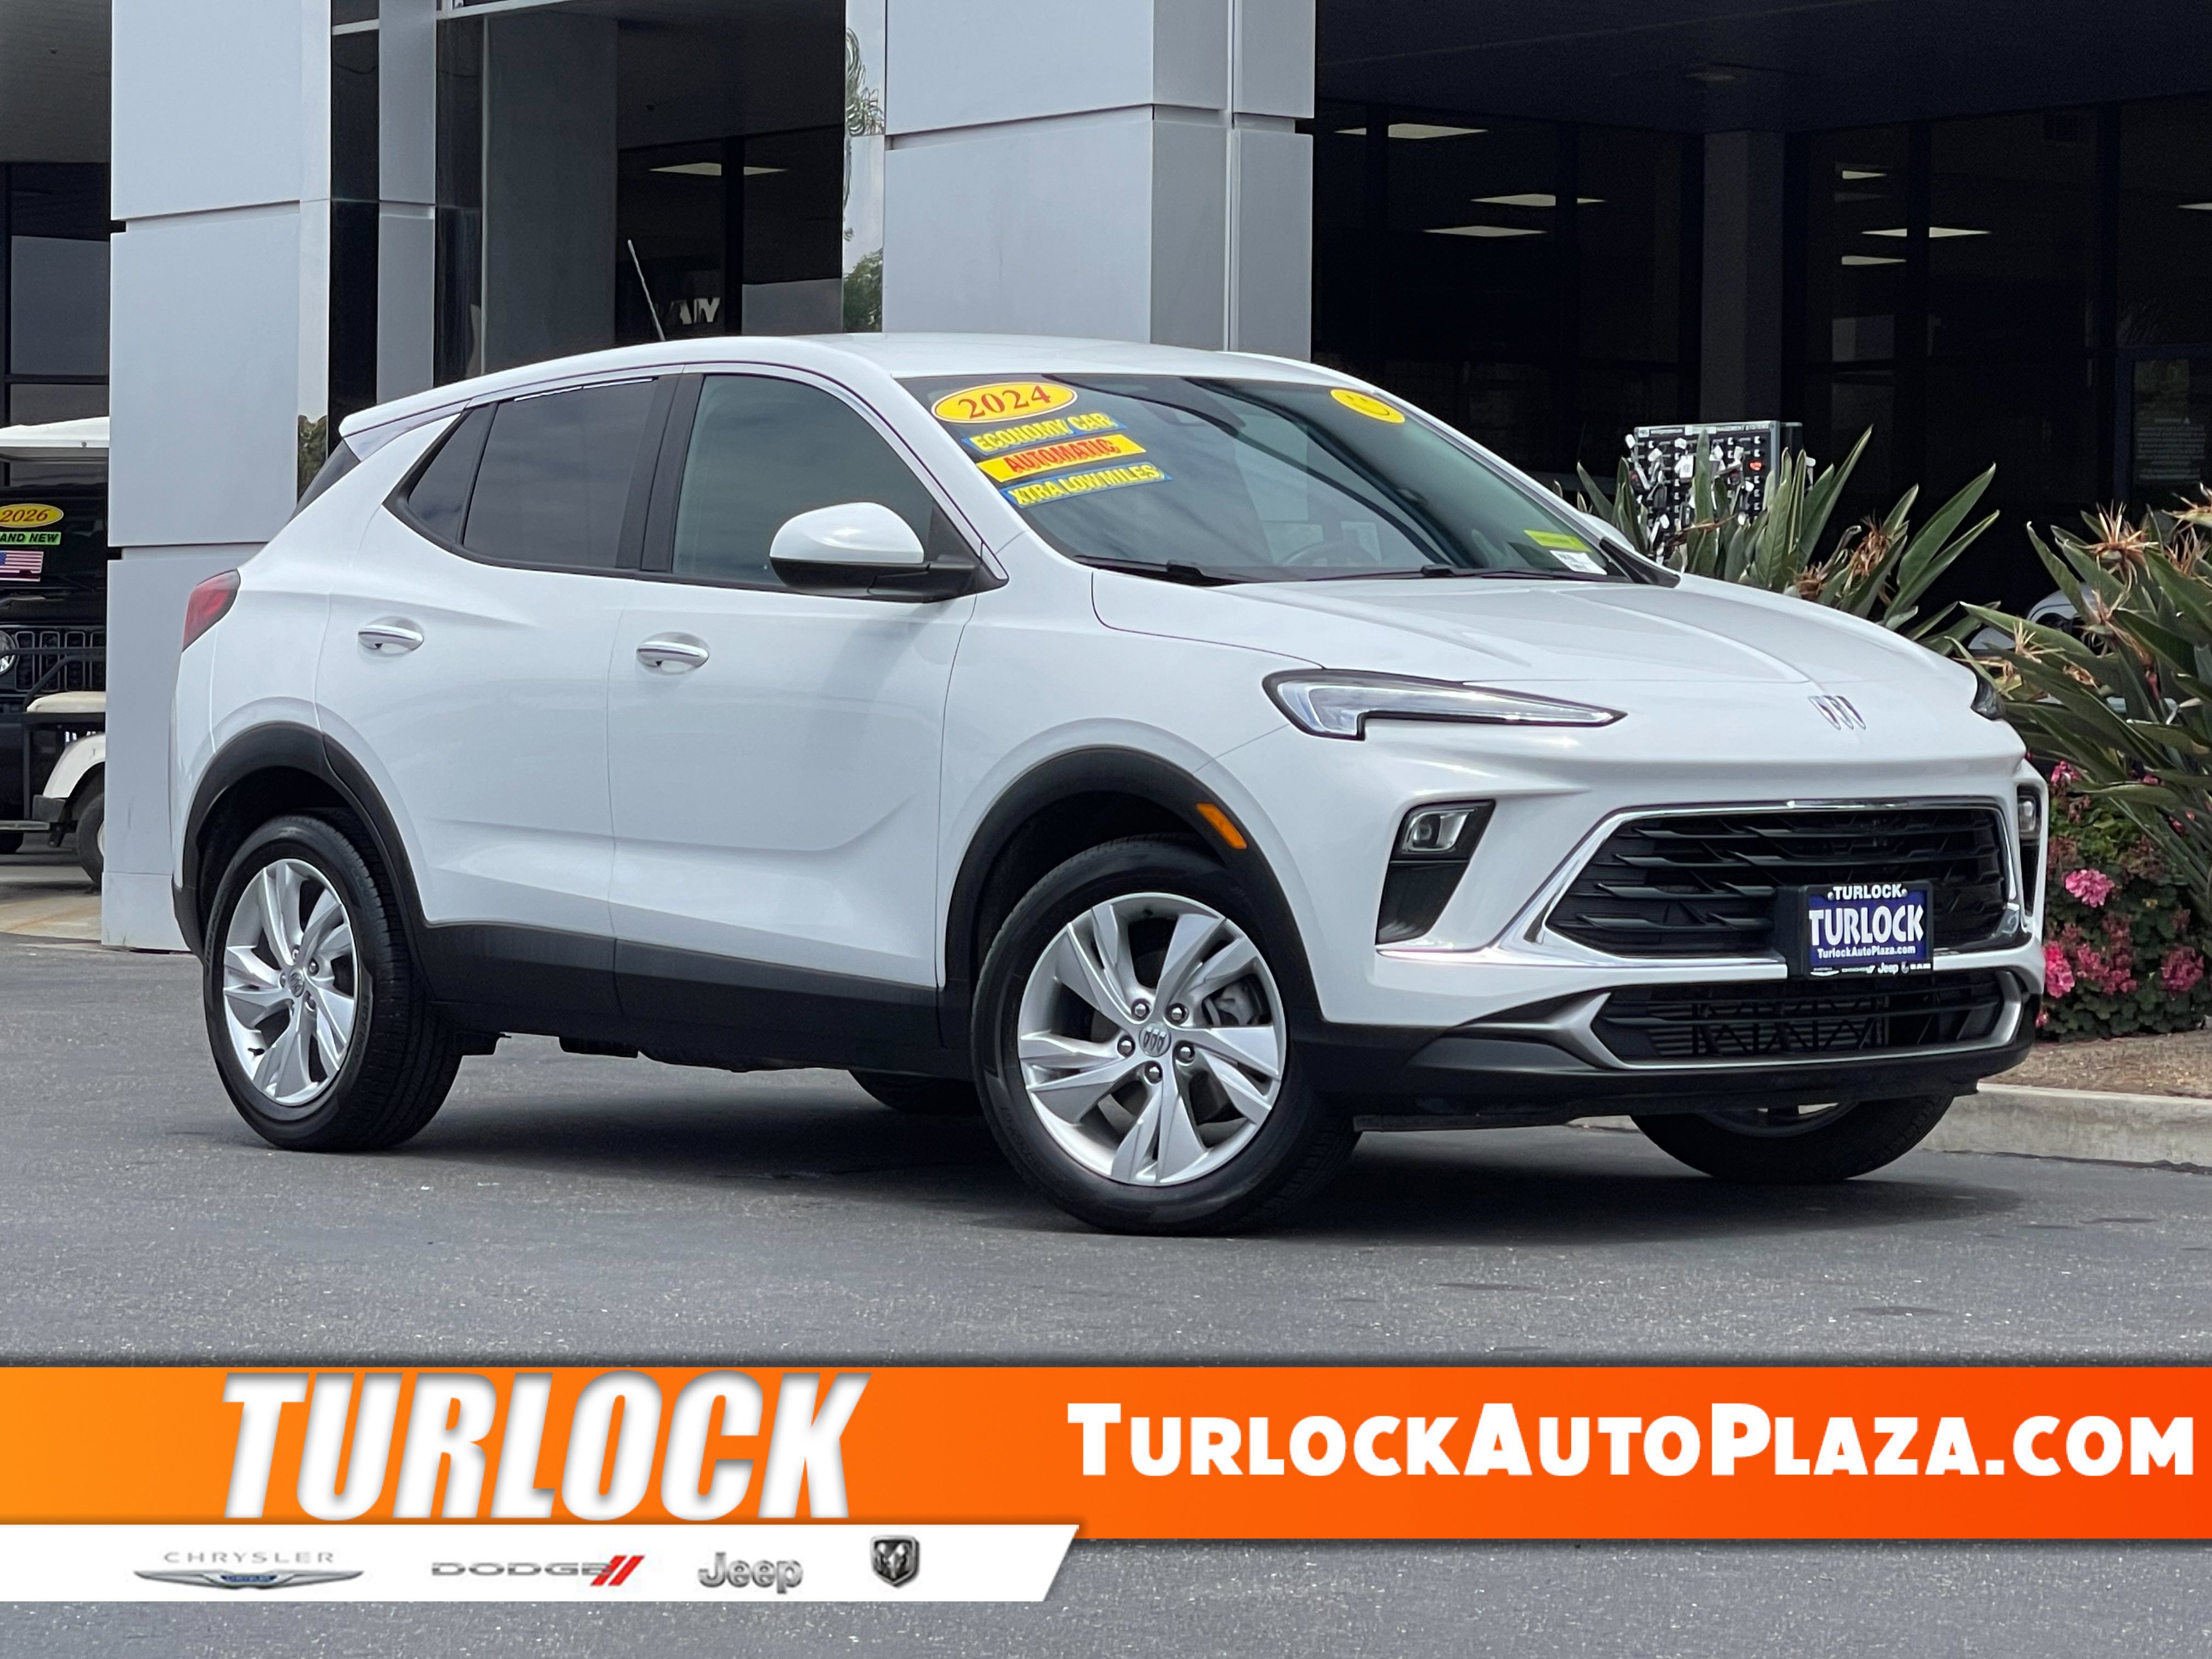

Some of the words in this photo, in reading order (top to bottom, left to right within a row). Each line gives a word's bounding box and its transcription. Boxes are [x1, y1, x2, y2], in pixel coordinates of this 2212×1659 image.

[958, 385, 1051, 419] 2024
[970, 420, 1072, 452] ECONOMY
[1069, 413, 1116, 430] CAR
[1003, 438, 1121, 473] AUTOMATIC
[1008, 479, 1062, 505] XTRA
[1059, 471, 1104, 495] LOW
[1102, 464, 1165, 485] MILES
[0, 509, 52, 522] 2026
[29, 533, 59, 543] NEW
[1832, 884, 1903, 900] TURLOCK
[1809, 904, 1924, 946] TURLOCK
[1817, 945, 1916, 959] TurlockAutoPlaza.com
